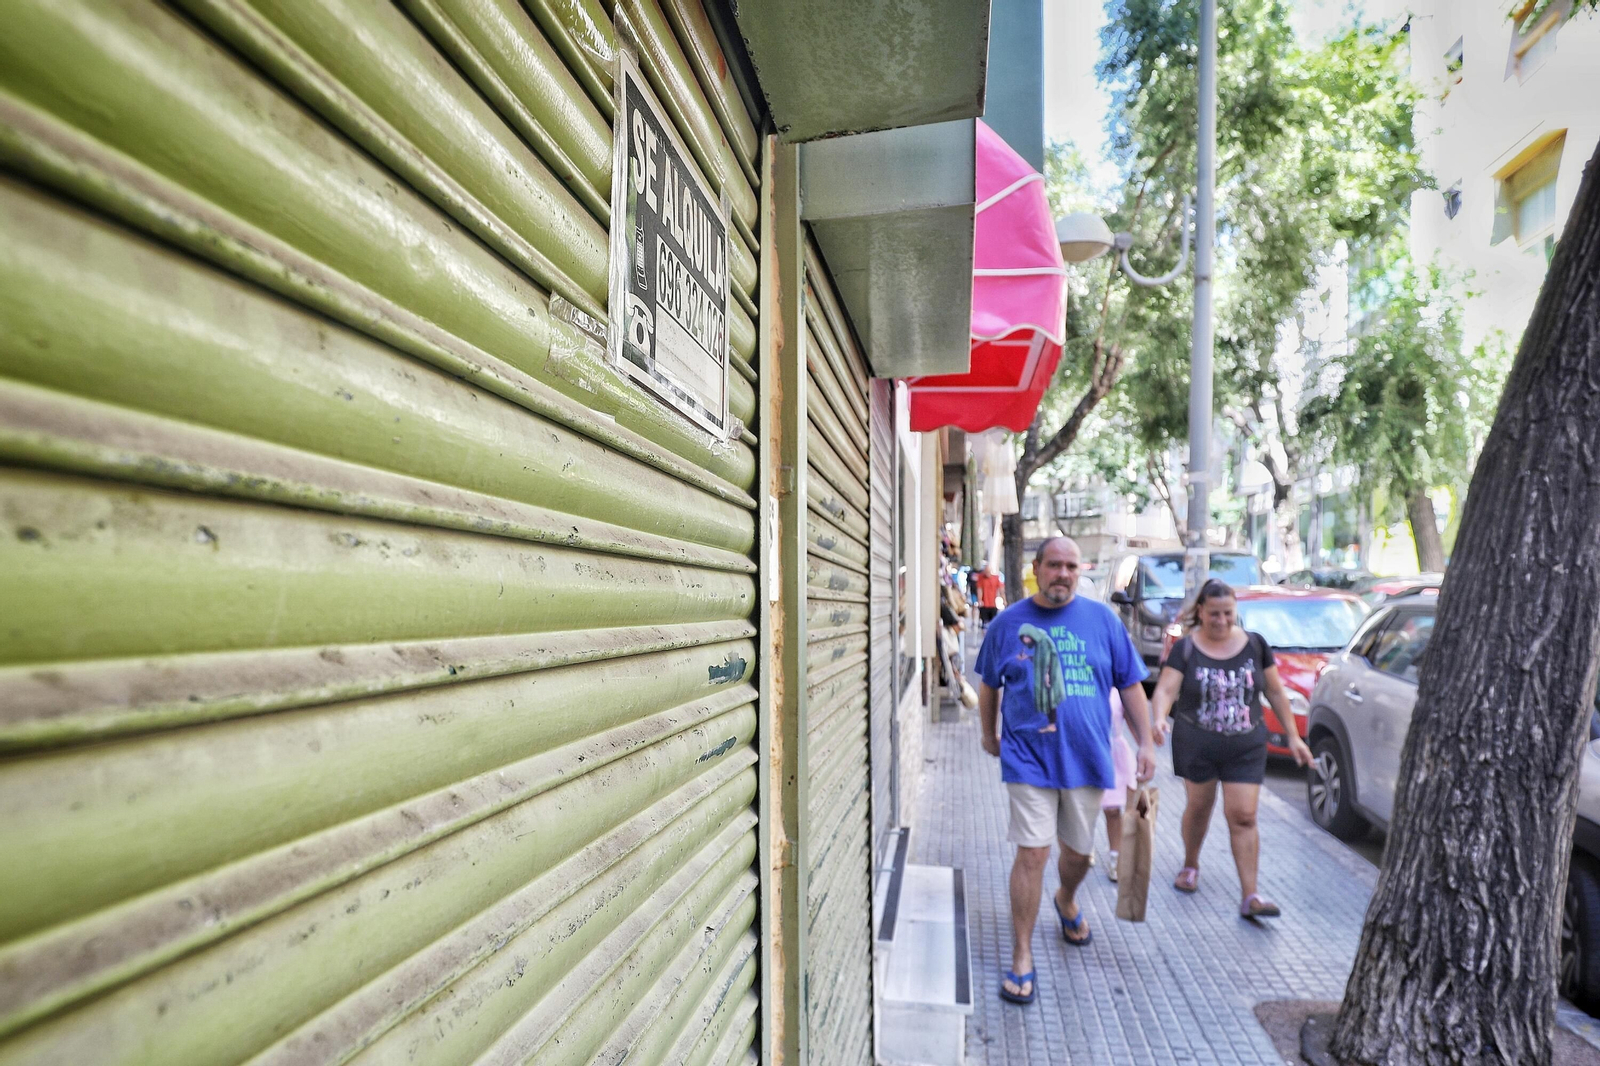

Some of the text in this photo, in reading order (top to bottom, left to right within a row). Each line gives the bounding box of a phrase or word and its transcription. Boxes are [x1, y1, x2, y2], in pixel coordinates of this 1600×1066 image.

[632, 108, 725, 302] SE ALQUILA
[660, 242, 724, 363] 696 324 026
[1050, 626, 1067, 639] WE
[1057, 639, 1087, 652] DON'T
[1062, 654, 1087, 667] TALK
[1065, 668, 1094, 682] ABOUT
